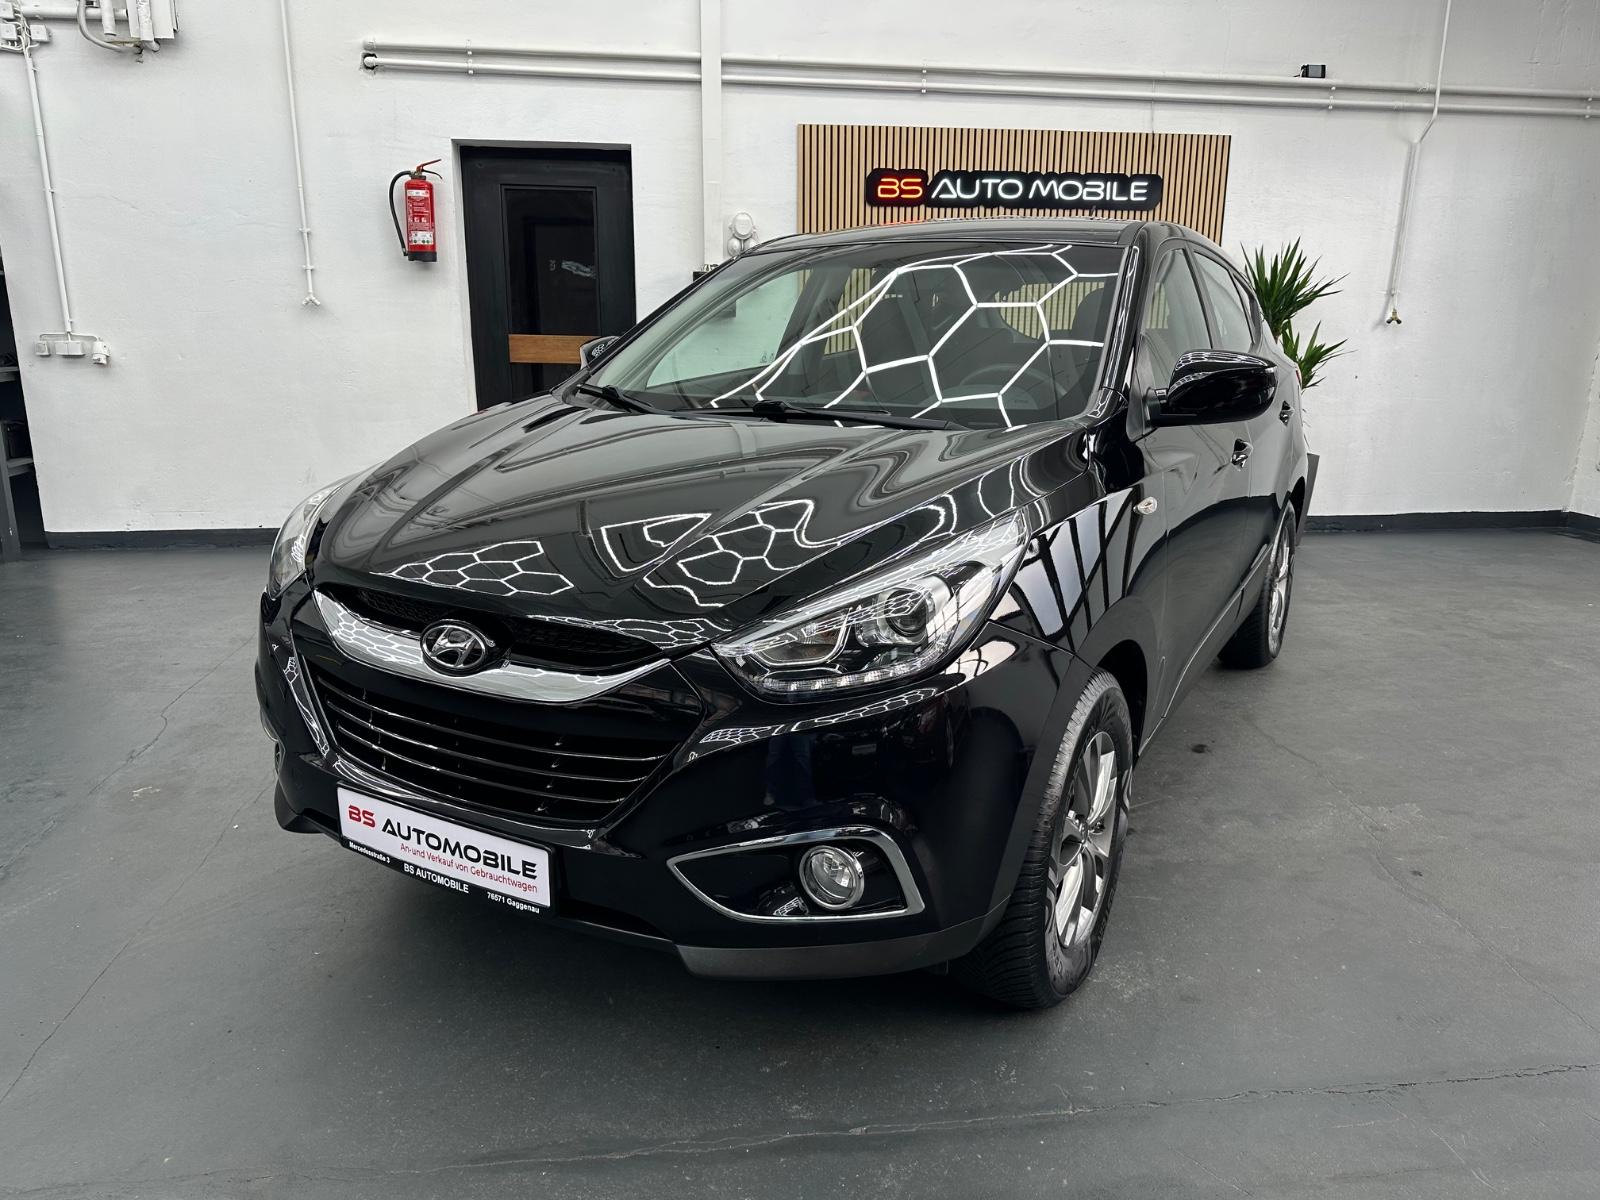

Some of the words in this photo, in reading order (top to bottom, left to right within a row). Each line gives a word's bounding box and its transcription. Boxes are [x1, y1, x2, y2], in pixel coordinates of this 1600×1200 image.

[877, 177, 923, 199] BS
[348, 804, 376, 828] BS
[381, 817, 538, 880] AUTOMOBILE
[386, 856, 391, 864] 3
[426, 851, 454, 868] Verkauf
[455, 861, 469, 873] von
[470, 865, 538, 893] Gebrauchtwagen
[403, 862, 414, 874] BS
[415, 867, 469, 894] AUTOMOBILE
[486, 891, 505, 904] 76571
[506, 898, 540, 914] Gaggenau
